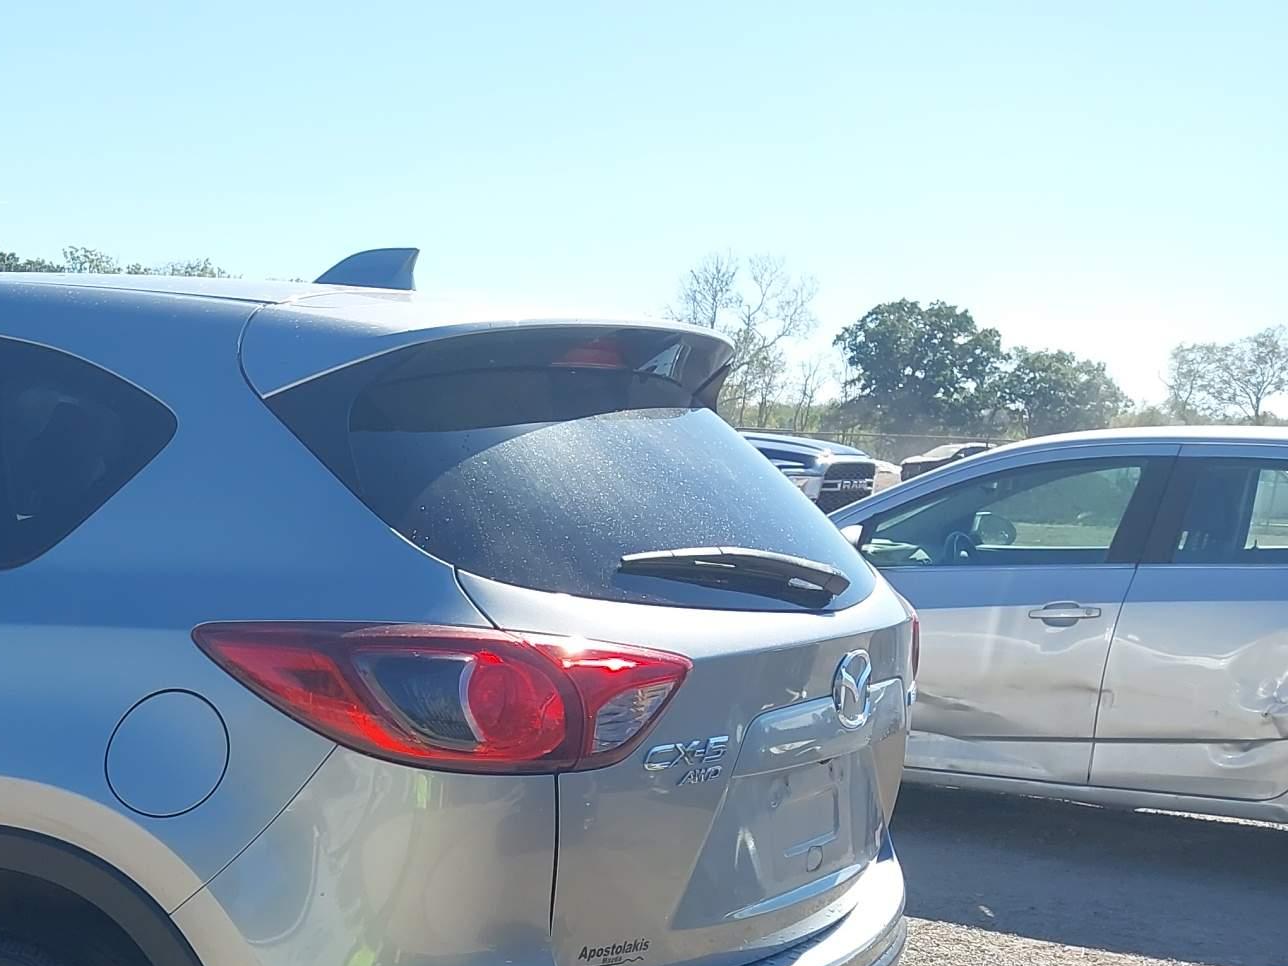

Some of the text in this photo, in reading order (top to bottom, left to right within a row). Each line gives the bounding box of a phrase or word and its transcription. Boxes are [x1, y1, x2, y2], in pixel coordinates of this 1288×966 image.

[842, 480, 867, 489] RAM
[644, 736, 729, 771] CX-5
[678, 766, 722, 787] AWD
[578, 938, 650, 962] Apostolakis
